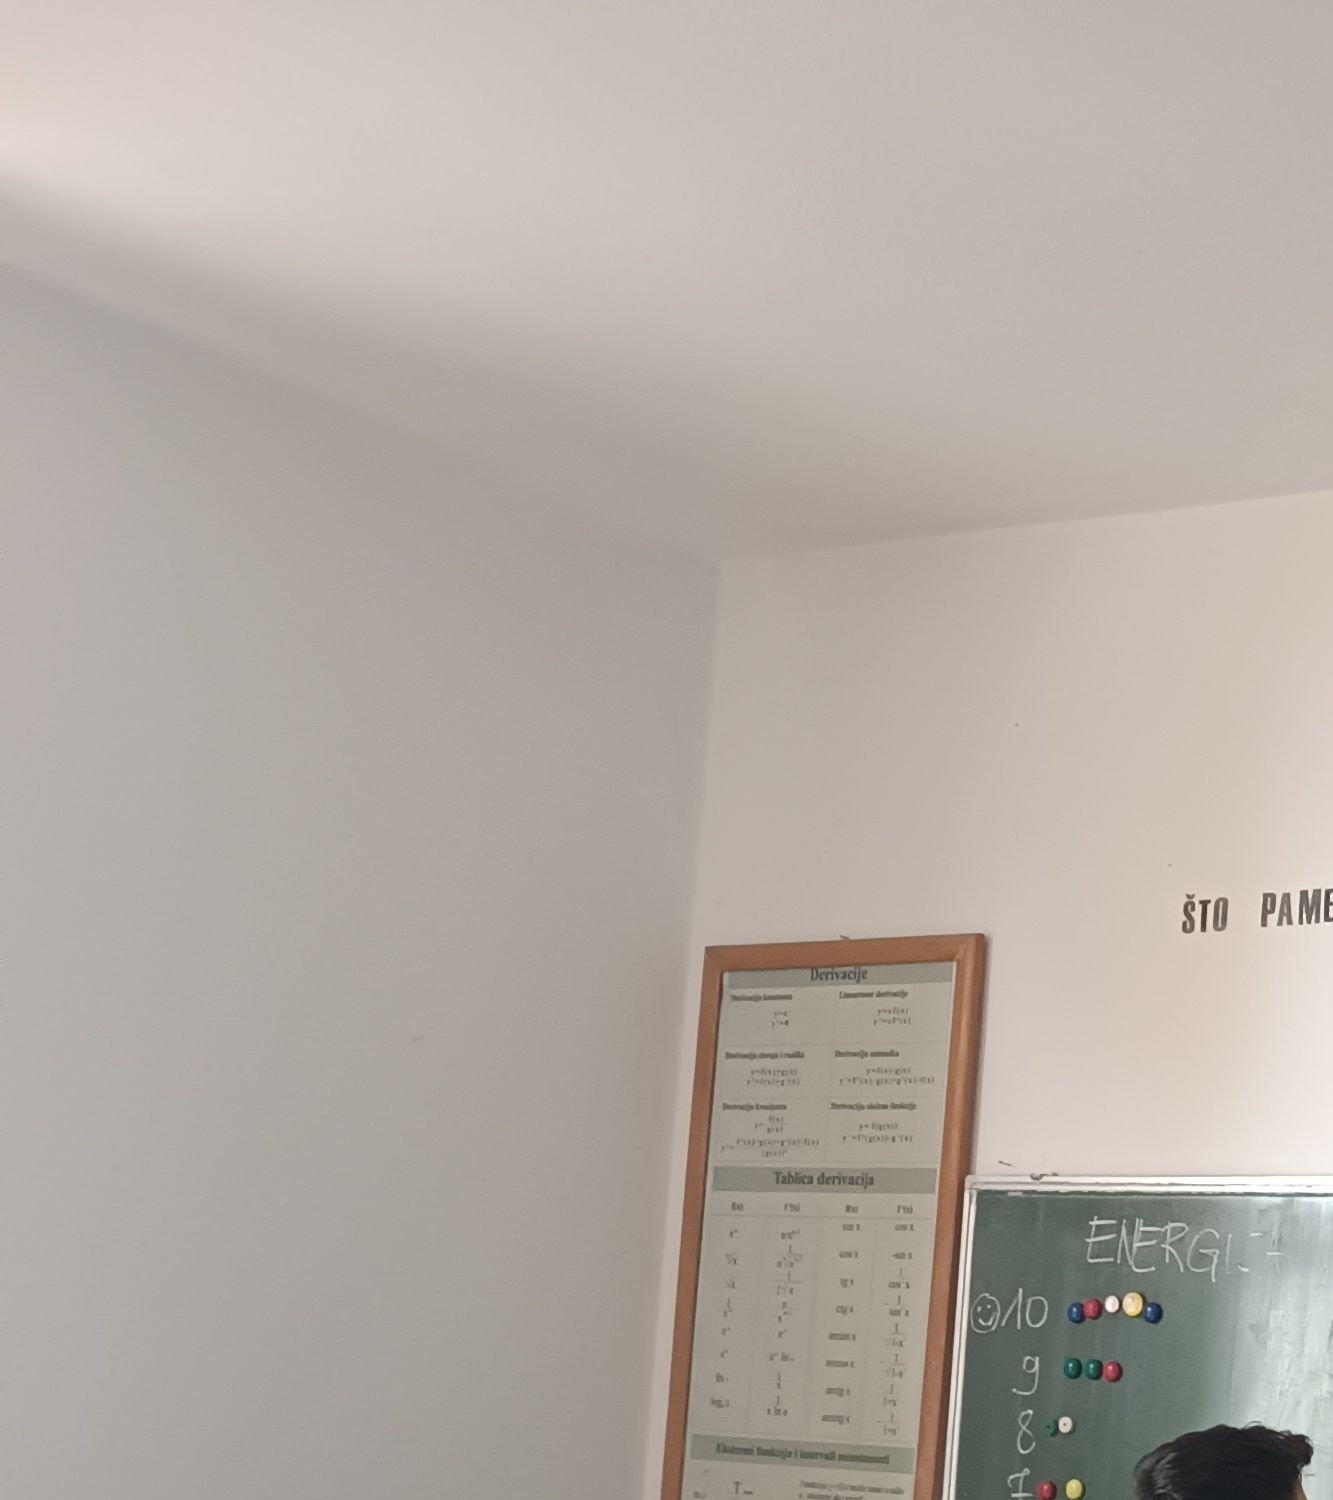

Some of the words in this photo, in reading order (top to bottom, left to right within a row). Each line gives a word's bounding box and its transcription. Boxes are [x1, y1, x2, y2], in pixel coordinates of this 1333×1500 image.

[1180, 893, 1229, 936] ŠTO
[774, 1170, 814, 1187] Tablica
[816, 1171, 875, 1189] derivacija
[1001, 1288, 1049, 1330] 10
[1012, 1355, 1040, 1395] 9
[1016, 1409, 1037, 1455] 8
